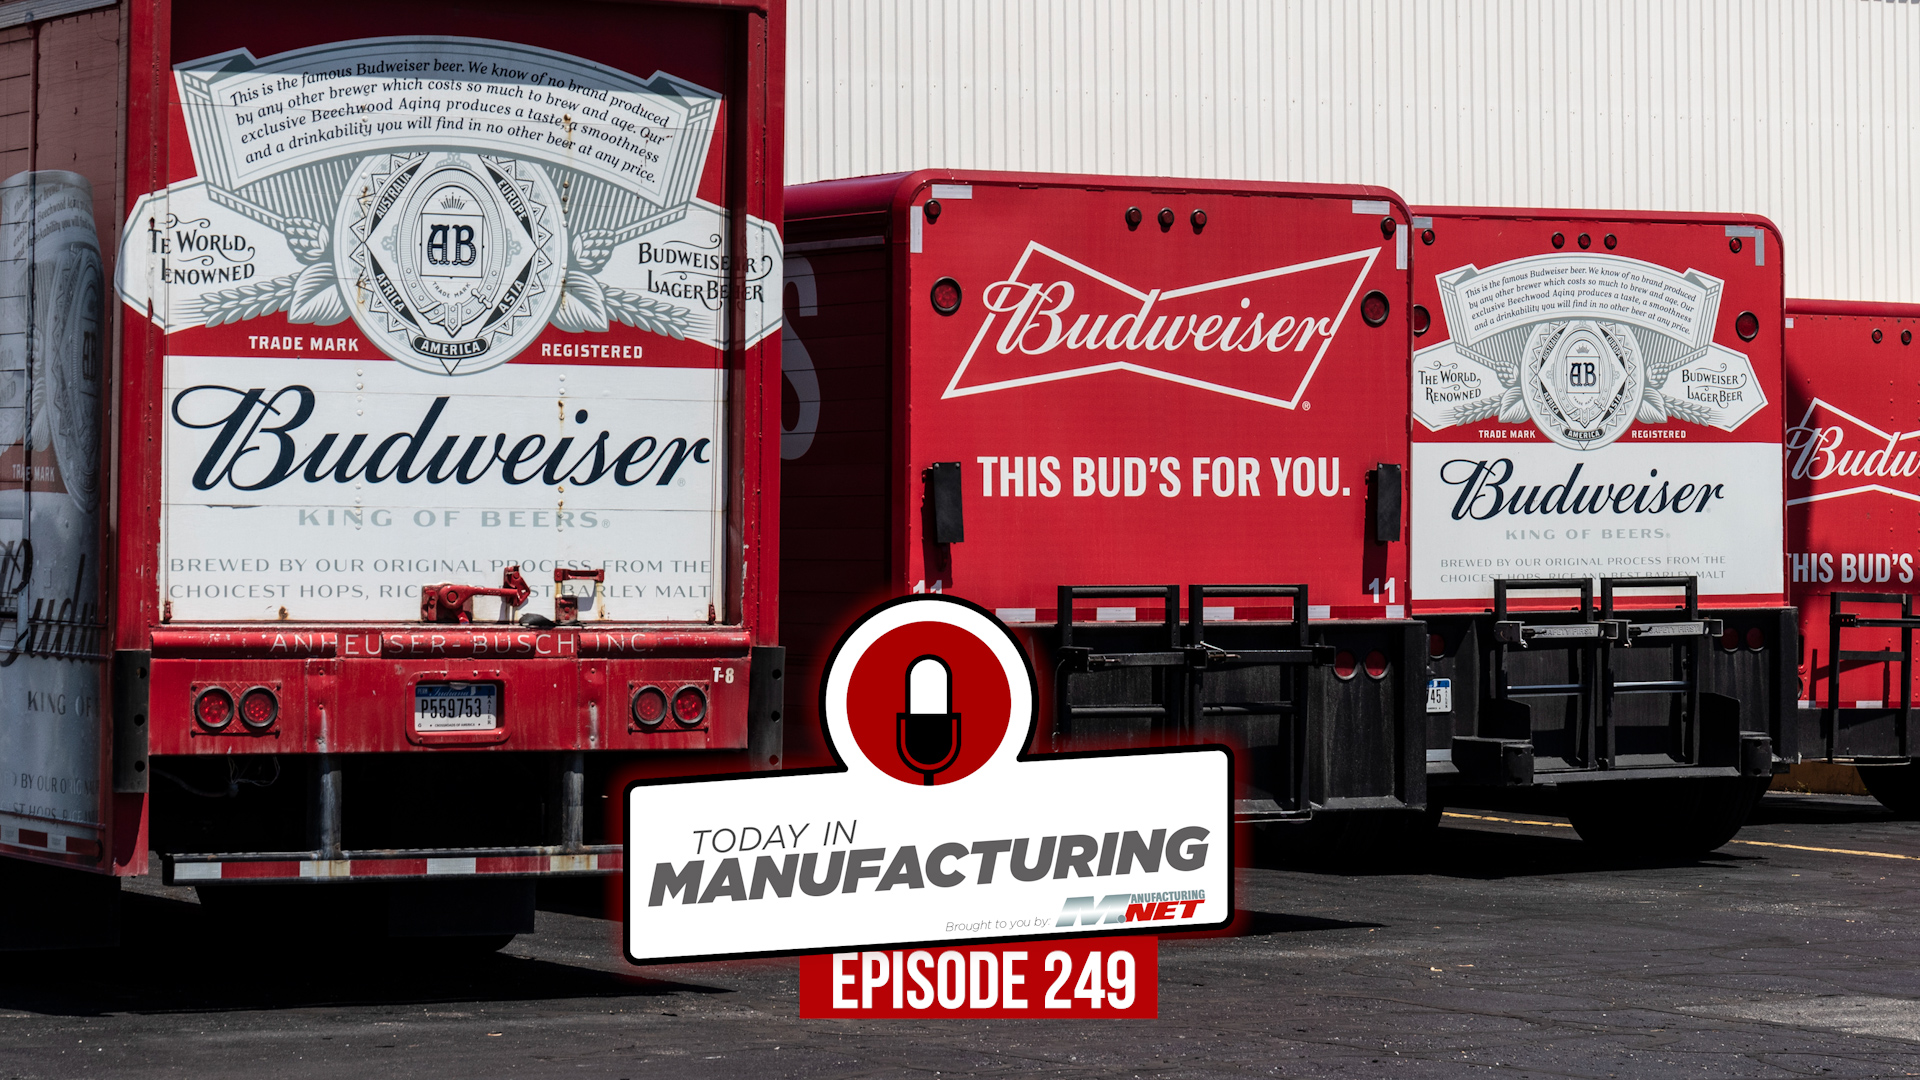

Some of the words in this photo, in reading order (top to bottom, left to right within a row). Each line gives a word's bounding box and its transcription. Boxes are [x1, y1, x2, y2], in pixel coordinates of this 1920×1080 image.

[230, 89, 259, 107] This
[262, 83, 273, 96] is
[277, 77, 298, 91] the
[301, 67, 352, 88] famous
[356, 60, 430, 76] Budweiser
[433, 59, 465, 72] beer.
[468, 61, 488, 74] We
[491, 63, 529, 80] know
[531, 72, 548, 85] of
[547, 77, 565, 88] no
[568, 79, 609, 102] brand
[609, 95, 670, 128] produced
[235, 113, 254, 126] by
[257, 102, 283, 118] any
[288, 91, 325, 108] other
[329, 83, 378, 100] brewer
[382, 77, 423, 92] which
[427, 79, 462, 91] costs
[466, 82, 482, 93] so
[486, 84, 524, 99] much
[528, 89, 542, 100] to
[545, 92, 580, 111] brew
[582, 105, 609, 121] and
[611, 116, 636, 134] age.
[640, 127, 665, 145] Our
[241, 116, 306, 144] exclusive
[311, 98, 393, 123] Beechwood
[398, 97, 441, 113] Aging
[446, 98, 512, 115] produces
[515, 107, 524, 118] a
[528, 108, 565, 130] taste,
[569, 121, 578, 131] a
[580, 124, 659, 163] smoothness
[245, 144, 272, 163] and
[276, 142, 285, 153] a
[288, 122, 372, 150] drinkability
[377, 120, 402, 134] you
[407, 116, 432, 129] will
[435, 115, 464, 132] find
[468, 118, 481, 131] in
[486, 123, 503, 134] no
[507, 125, 544, 142] other
[546, 131, 576, 150] beer
[578, 144, 593, 156] at
[595, 150, 620, 169] any
[621, 160, 655, 184] price.
[376, 173, 411, 219] AUSTRALIA
[498, 180, 528, 221] EUROPE
[176, 229, 253, 260] WORLD
[427, 224, 477, 267] AB
[376, 273, 405, 312] AFRICA
[1501, 273, 1528, 286] famous
[1530, 267, 1568, 278] Budweiser
[1663, 284, 1696, 302] produced
[499, 281, 525, 313] ASIA
[1471, 300, 1505, 320] exclusive
[1507, 290, 1550, 306] Beechwood
[1577, 289, 1612, 298] produces
[1649, 302, 1692, 323] smoothness
[983, 279, 1333, 355] Budweiser
[1496, 304, 1539, 322] drinkability
[248, 335, 303, 350] TRADE
[310, 336, 359, 352] MARK
[421, 338, 481, 356] AMERICA
[541, 343, 643, 359] REGISTERED
[1418, 370, 1438, 385] THE
[1440, 369, 1480, 387] WORLD
[1570, 362, 1597, 387] AB
[1682, 369, 1740, 385] BUDWEISER
[1426, 387, 1481, 404] RENOWNED
[1543, 391, 1559, 414] AFRICA
[1610, 394, 1622, 413] ASIA
[171, 384, 711, 492] Budweiser
[1479, 430, 1507, 439] TRADE
[1510, 430, 1536, 439] MARK
[1567, 430, 1600, 439] AMERICA
[1631, 430, 1687, 439] REGISTERED
[34, 467, 55, 483] MARK
[977, 455, 1061, 497] THIS
[1072, 456, 1181, 497] BUD'S
[1192, 456, 1260, 497] FOR
[1271, 456, 1351, 497] YOU.
[1440, 458, 1724, 521] Budweiser
[298, 508, 393, 527] KING
[413, 509, 461, 528] OF
[1505, 528, 1556, 541] KING
[1565, 528, 1592, 541] OF
[170, 558, 271, 573] BREWED
[279, 558, 307, 573] BY
[315, 558, 365, 573] OUR
[373, 558, 484, 574] ORIGINAL
[602, 560, 663, 574] FROM
[670, 560, 711, 574] THE
[1440, 558, 1492, 568] BREWED
[1496, 558, 1511, 567] BY
[1515, 558, 1541, 567] OUR
[1545, 557, 1603, 567] ORIGINAL
[1607, 556, 1662, 566] PROCESS
[1666, 556, 1700, 565] FROM
[1703, 555, 1726, 565] THE
[1841, 553, 1915, 583] BUD'S
[1440, 573, 1504, 583] CHOICEST
[1696, 570, 1726, 579] MALT
[169, 584, 291, 599] CHOICEST
[300, 584, 370, 601] HOPS,
[379, 585, 419, 599] RIC
[561, 585, 650, 599] BARLEY
[655, 585, 712, 599] MALT
[1368, 577, 1396, 604] 11
[713, 667, 735, 684] T-8
[432, 688, 469, 696] Indiana
[27, 690, 66, 716] KING
[421, 698, 481, 719] P559753
[21, 773, 34, 790] BY
[37, 774, 58, 794] OUR
